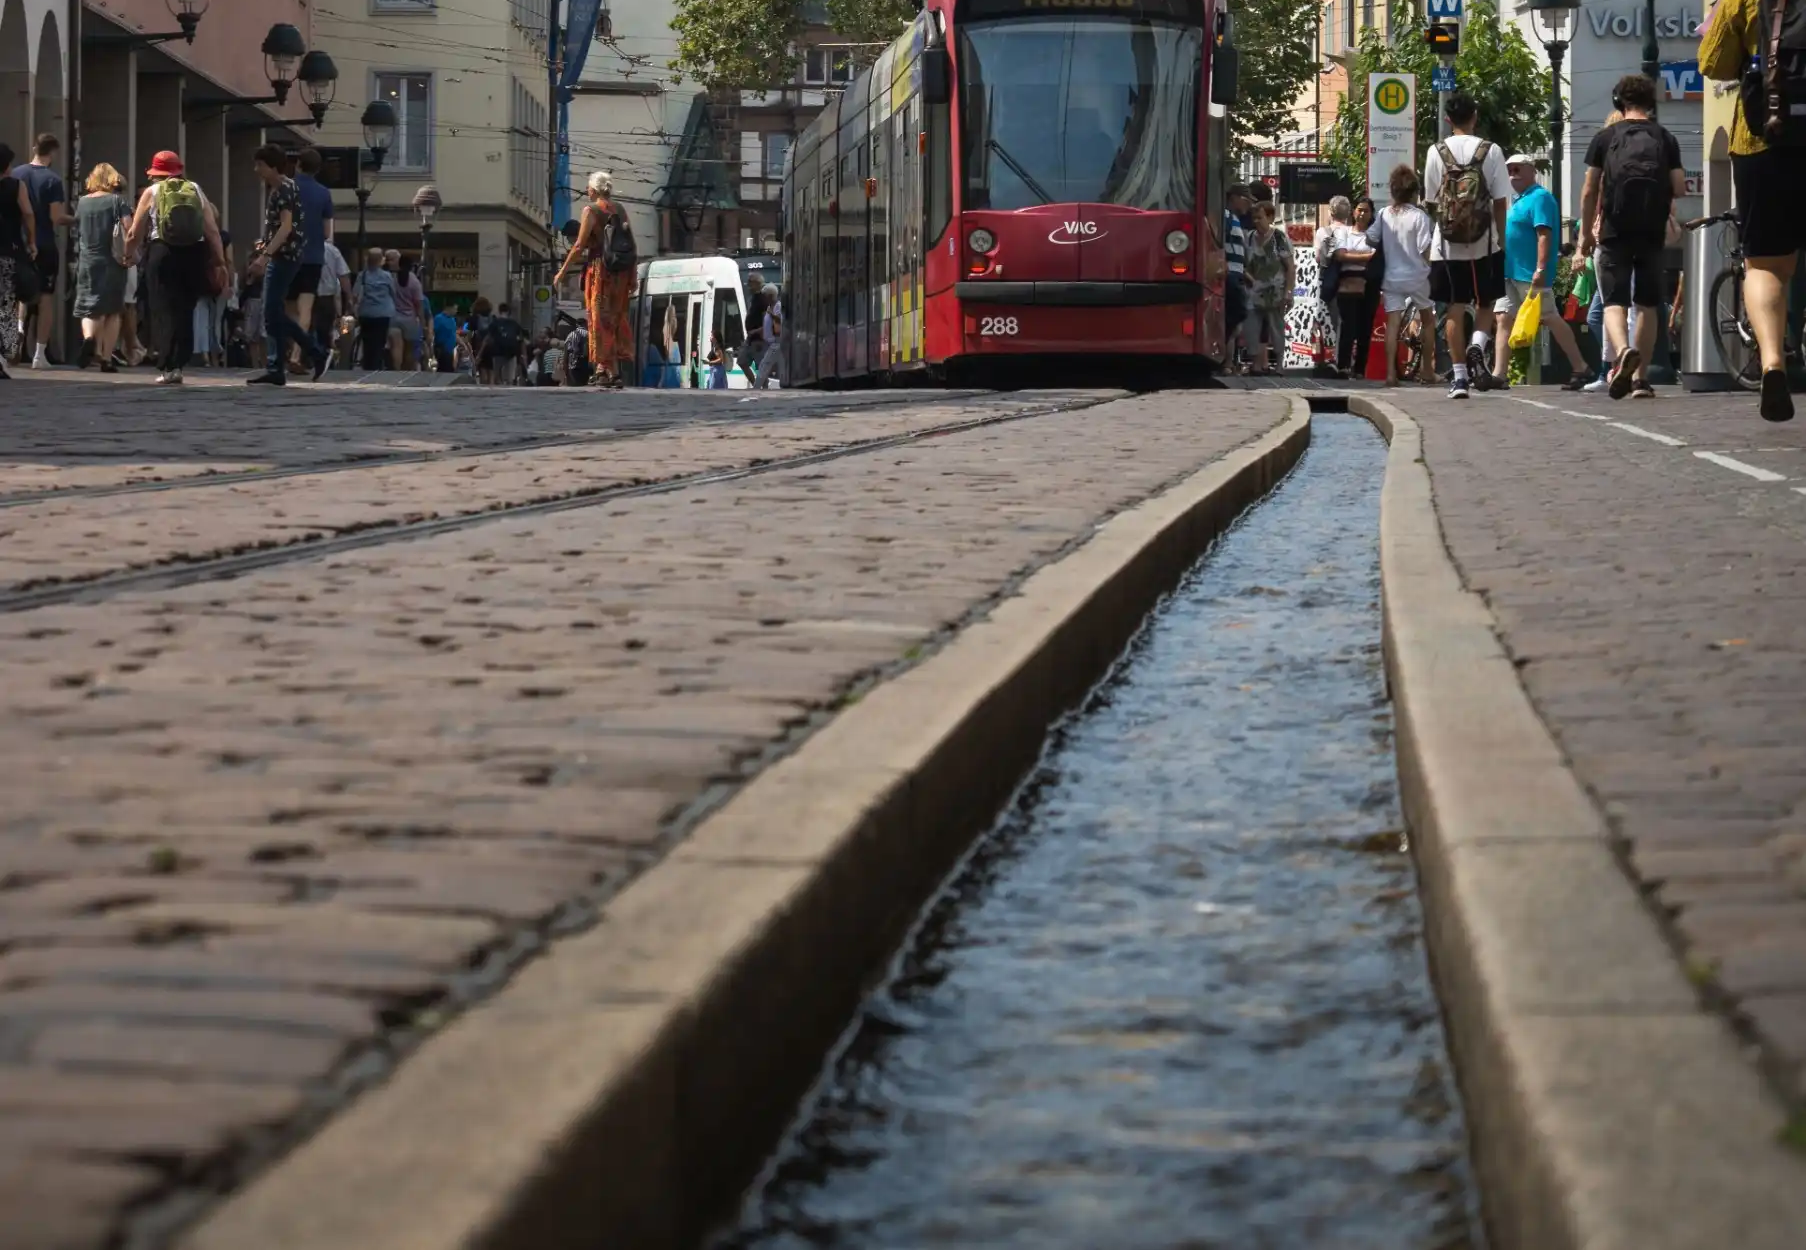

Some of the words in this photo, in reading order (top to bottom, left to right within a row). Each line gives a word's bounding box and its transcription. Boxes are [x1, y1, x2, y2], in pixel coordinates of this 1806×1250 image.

[1439, 69, 1449, 78] W
[1064, 221, 1097, 234] VAG
[981, 316, 1018, 335] 288
